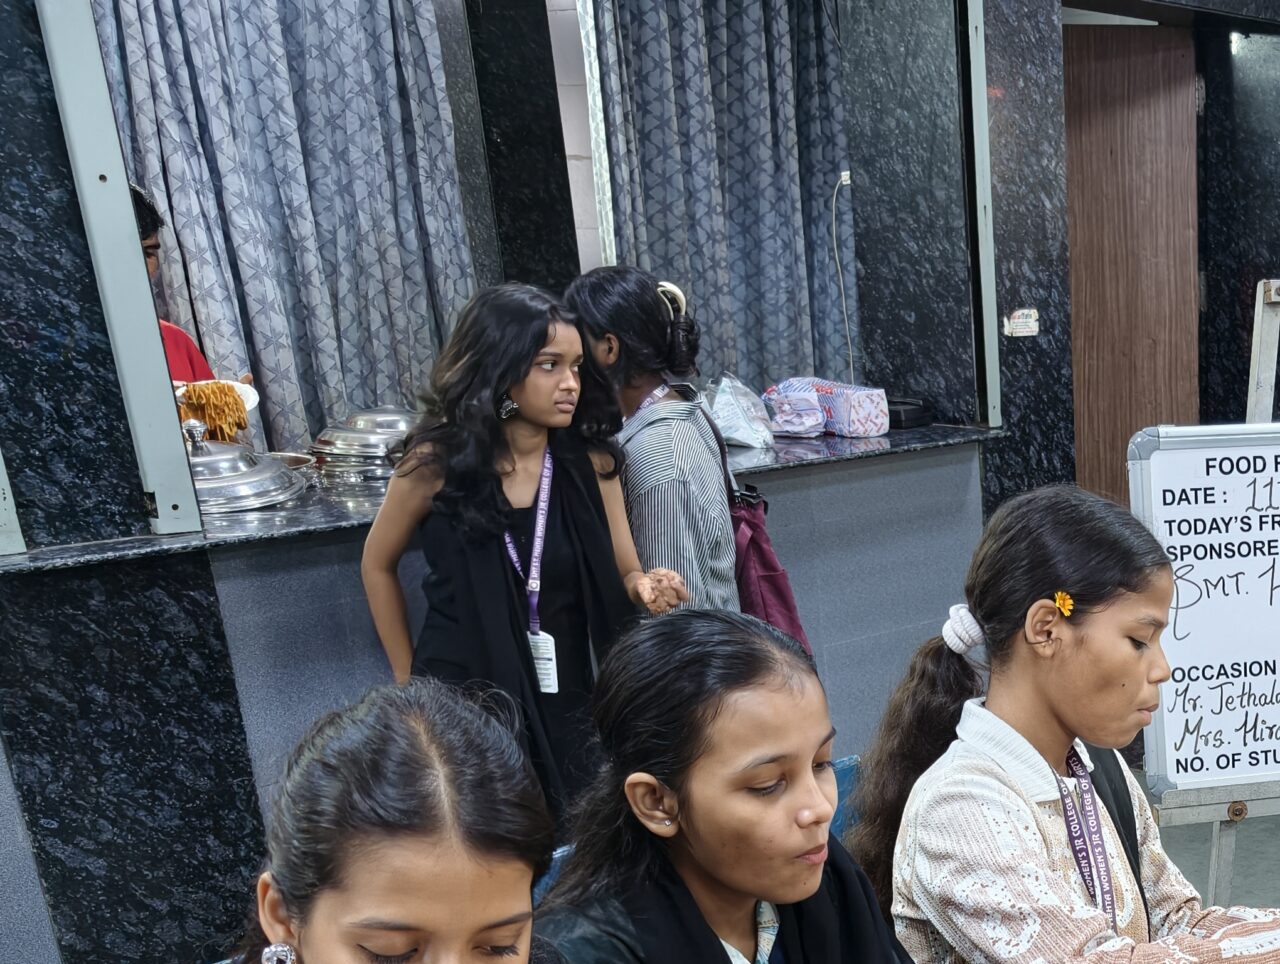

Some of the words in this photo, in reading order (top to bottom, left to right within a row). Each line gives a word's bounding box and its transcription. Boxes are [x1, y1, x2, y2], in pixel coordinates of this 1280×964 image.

[1205, 455, 1267, 476] FOOD
[1162, 486, 1216, 506] DATE
[1164, 516, 1253, 537] TODAY'S
[1171, 659, 1277, 684] OCCASION
[1167, 682, 1203, 714] Mr.
[1174, 716, 1232, 755] Mrs.
[1070, 757, 1086, 776] ARTS
[1175, 756, 1210, 774] NO.
[1216, 752, 1242, 770] OF
[1080, 778, 1089, 790] OF
[1064, 796, 1080, 837] COLLEGE
[1084, 792, 1098, 832] COLLEGE
[1074, 838, 1086, 850] JR
[1092, 834, 1102, 845] JR
[1078, 852, 1094, 895] WOMEN'S
[1095, 846, 1110, 892] WOMEN'S
